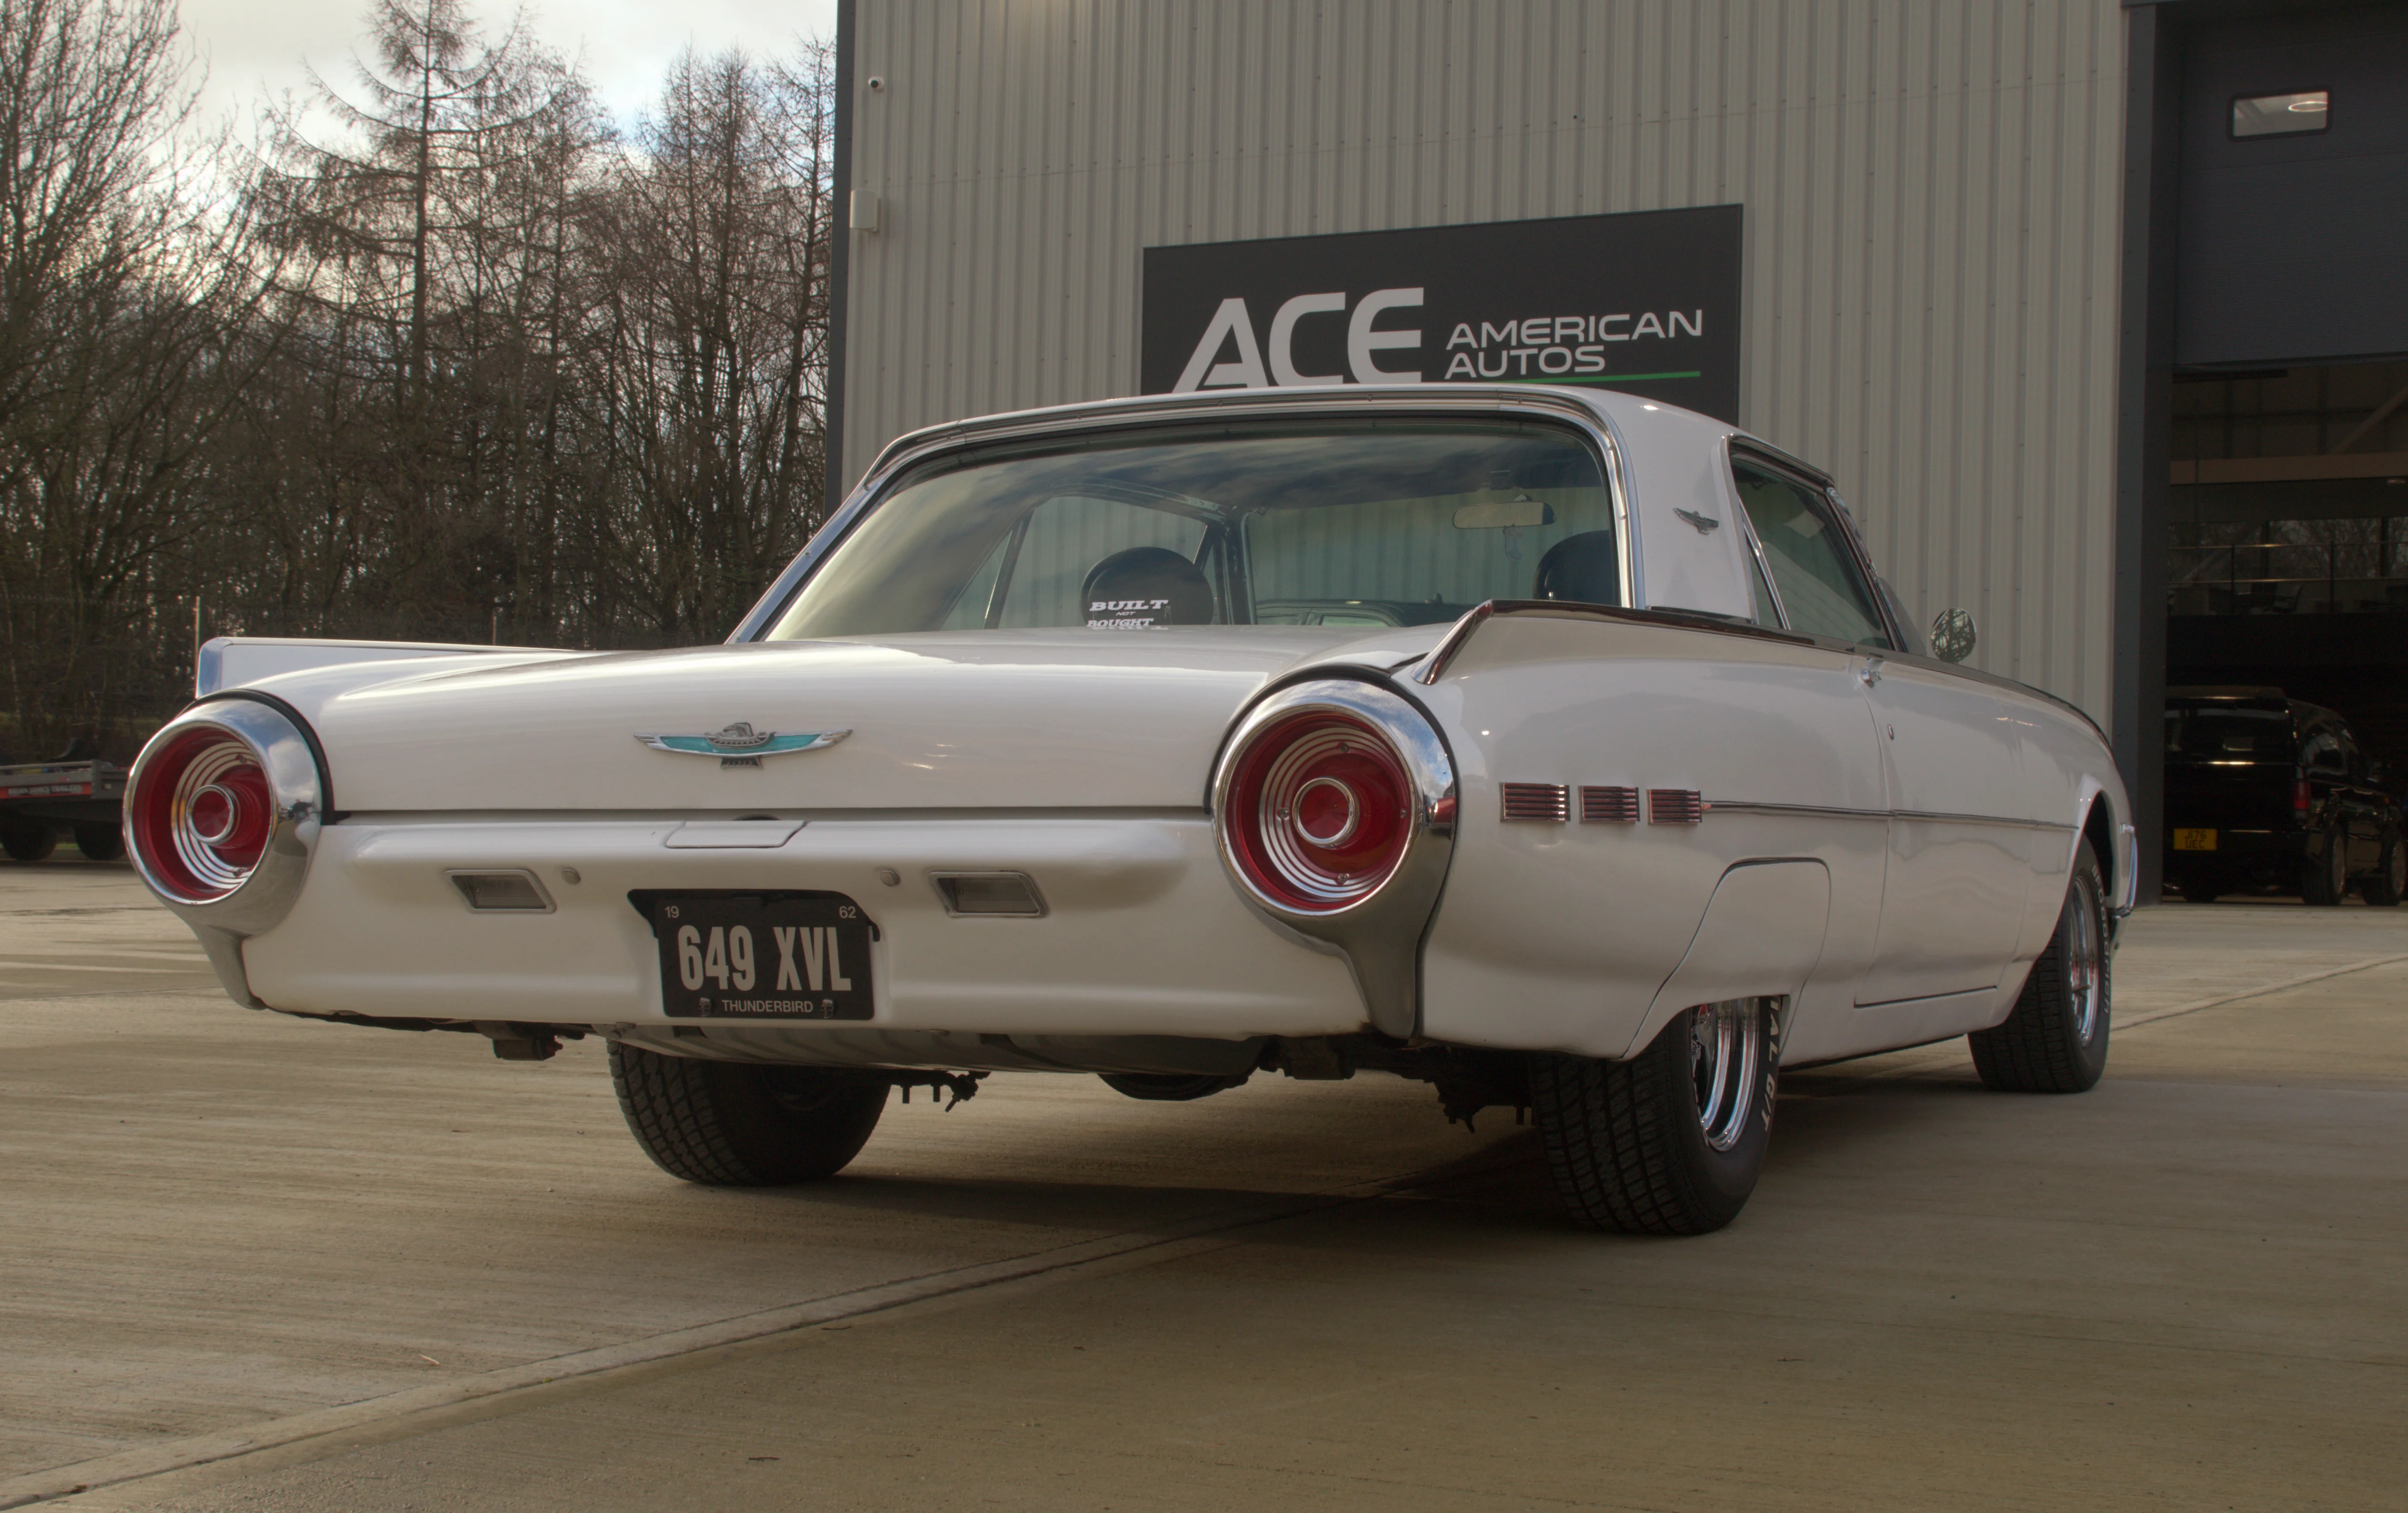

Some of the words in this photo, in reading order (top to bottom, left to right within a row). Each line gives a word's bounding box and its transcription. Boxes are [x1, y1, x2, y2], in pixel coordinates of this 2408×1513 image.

[1445, 309, 1703, 350] AMERICAN
[1170, 286, 1424, 393] ACE
[1444, 346, 1605, 379] AUTOS
[1089, 600, 1168, 611] BUILT
[1087, 618, 1154, 627] BOUGHT
[664, 906, 680, 918] 19
[839, 906, 857, 919] 62
[677, 925, 756, 992] 649
[772, 926, 852, 992] XVL
[721, 999, 814, 1013] THUNDERBIRD
